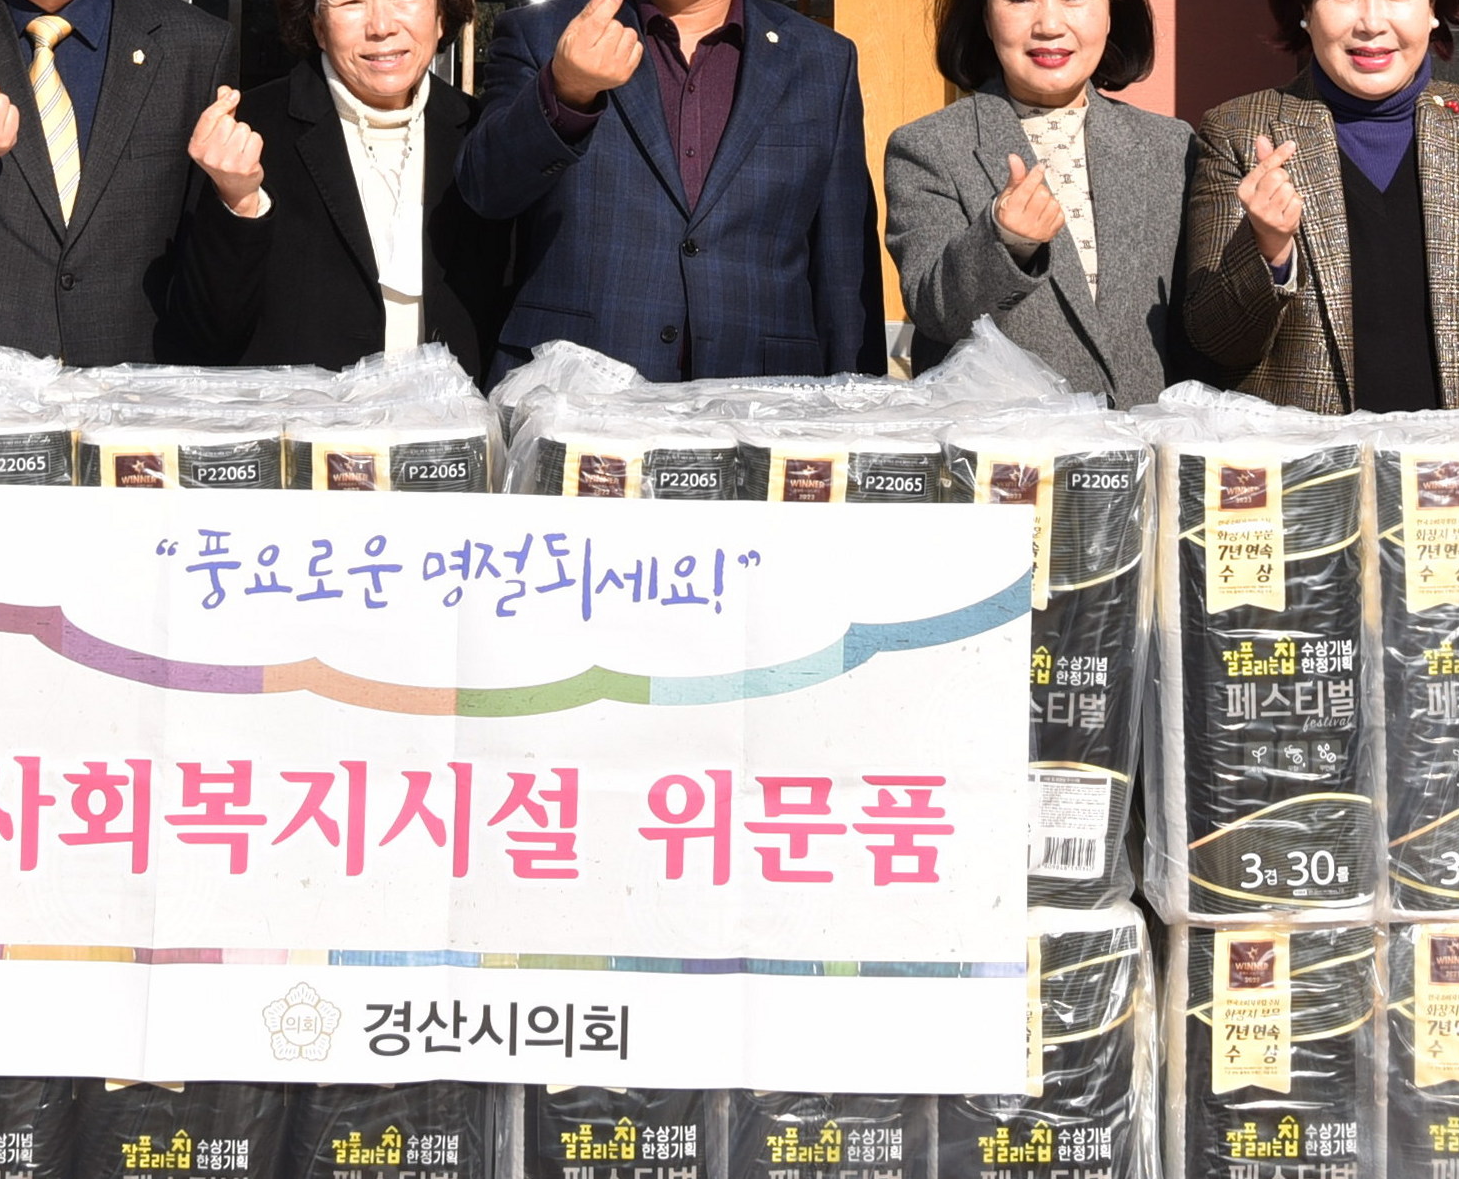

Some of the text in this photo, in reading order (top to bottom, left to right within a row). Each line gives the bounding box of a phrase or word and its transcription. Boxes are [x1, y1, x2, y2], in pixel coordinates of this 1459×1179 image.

[197, 466, 257, 482] P22065
[408, 464, 467, 479] P22065
[660, 471, 717, 488] P22065
[864, 475, 923, 492] P22065
[1071, 473, 1129, 491] P22065
[1301, 640, 1352, 657] 수상기념
[1225, 679, 1354, 720] 페스티벌
[639, 768, 955, 886] 위문품
[286, 1016, 317, 1034] 의회
[363, 999, 629, 1060] 경산시의회
[642, 1125, 696, 1142] 수상기념
